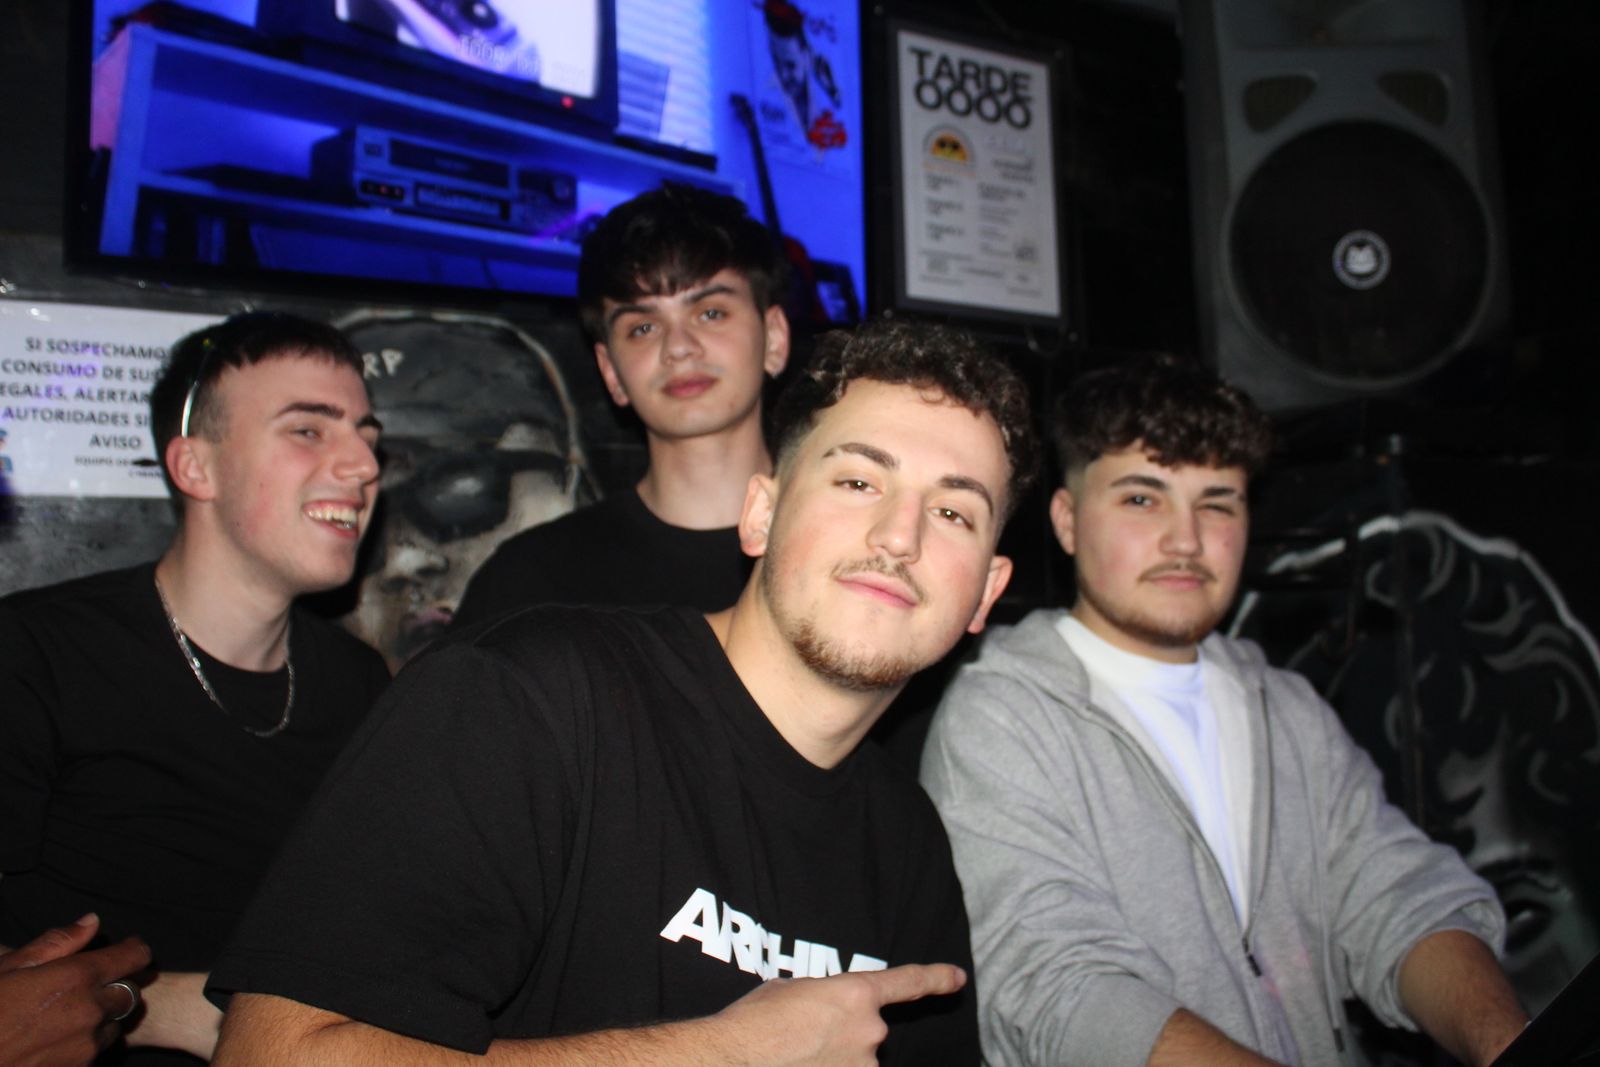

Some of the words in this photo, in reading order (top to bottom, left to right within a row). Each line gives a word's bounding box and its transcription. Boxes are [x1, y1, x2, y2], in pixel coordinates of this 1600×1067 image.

[908, 46, 1033, 102] TARDE
[25, 336, 41, 351] SI
[46, 337, 166, 360] SOSPECHAMO
[1, 358, 97, 378] CONSUMO
[102, 365, 123, 380] DE
[0, 382, 67, 400] EGALES,
[75, 387, 150, 403] ALERTAR
[2, 406, 128, 426] AUTORIDADES
[135, 413, 151, 427] SI
[89, 433, 141, 451] AVISO
